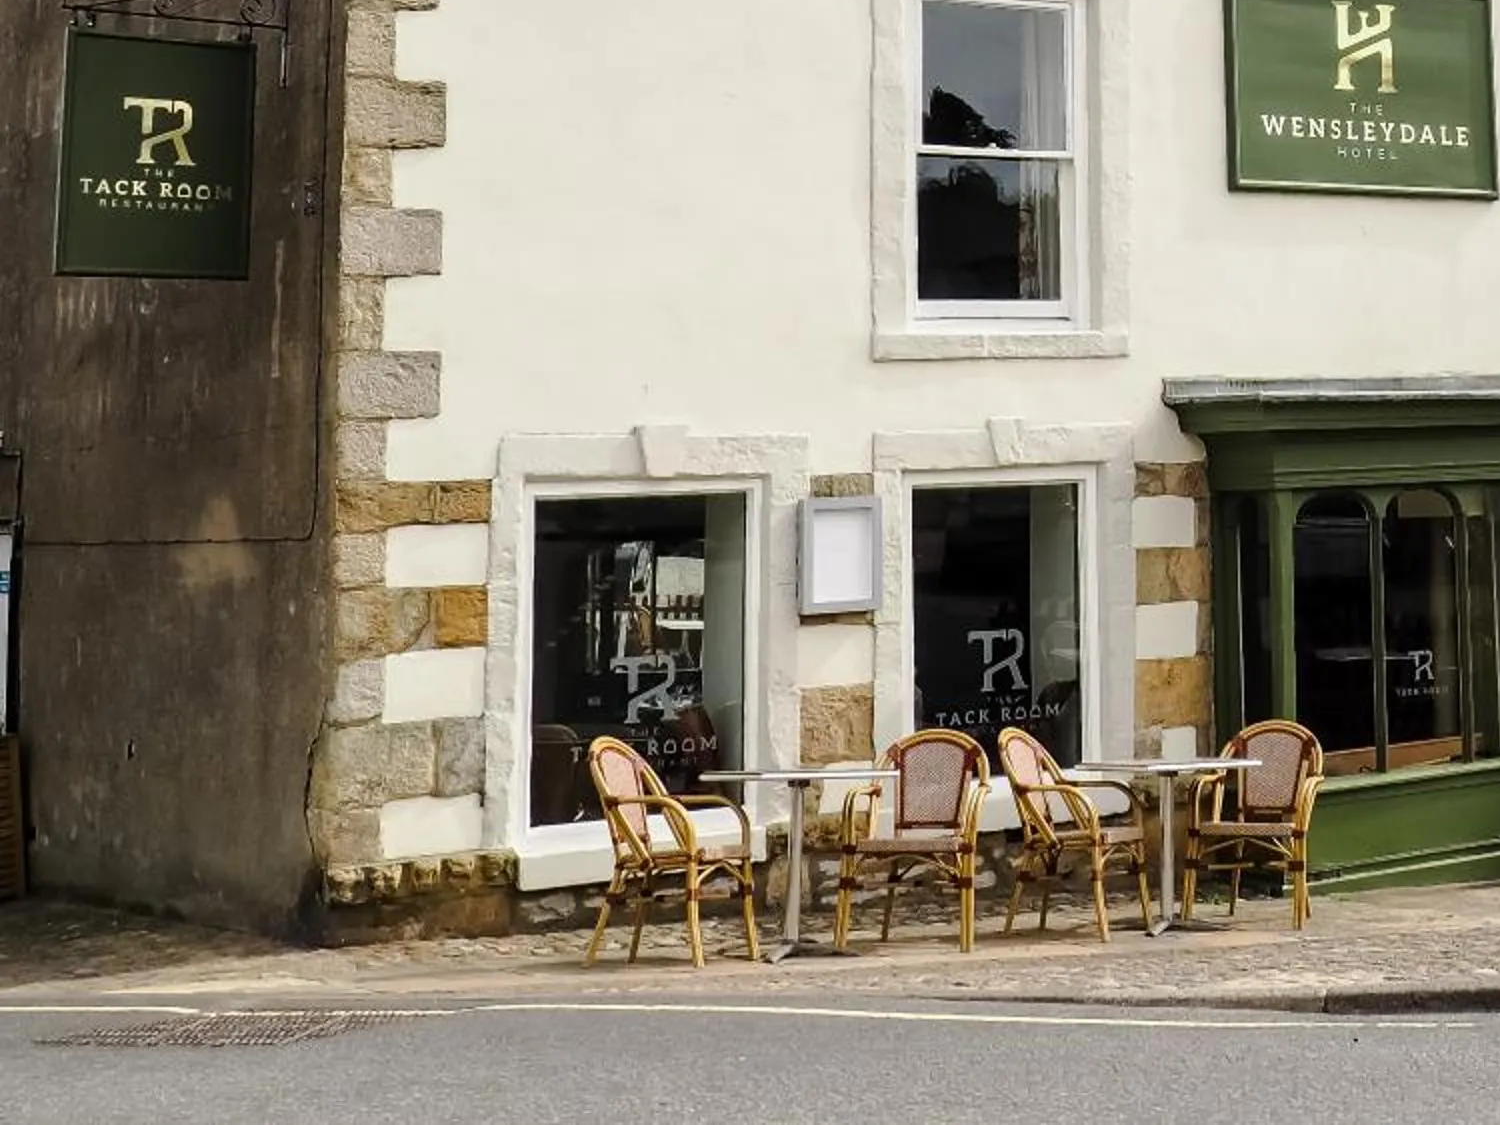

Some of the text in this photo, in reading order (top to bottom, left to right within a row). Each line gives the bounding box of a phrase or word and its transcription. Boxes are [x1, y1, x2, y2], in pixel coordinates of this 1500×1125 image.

[1349, 102, 1384, 116] THE
[1261, 114, 1470, 147] WENSLEYDALE
[1337, 146, 1398, 161] HOTEL
[143, 168, 174, 178] THE
[79, 177, 233, 202] TACK ROOM
[99, 198, 215, 212] RESTAURAN
[936, 703, 1060, 727] TACK ROOM
[647, 736, 717, 756] ROOM
